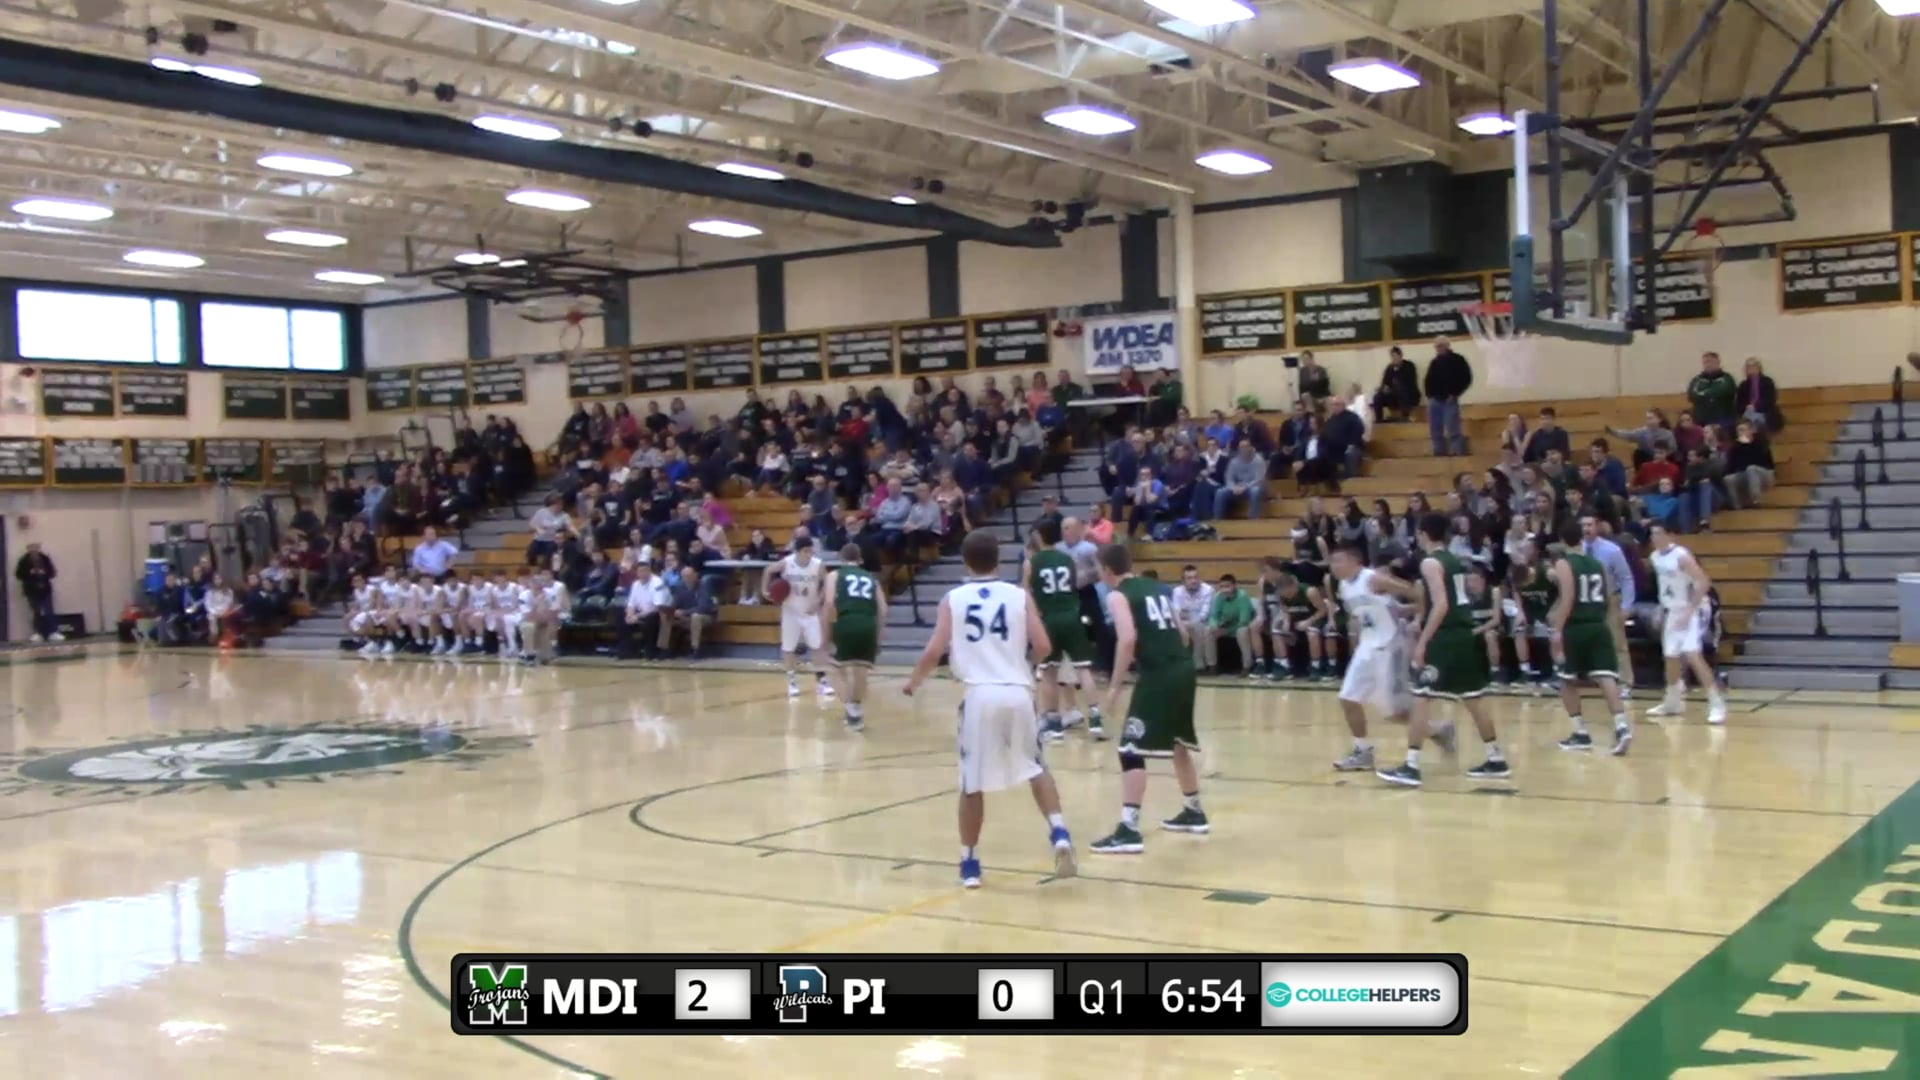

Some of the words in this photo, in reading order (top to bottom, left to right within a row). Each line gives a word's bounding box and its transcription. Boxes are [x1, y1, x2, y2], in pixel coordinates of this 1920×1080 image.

[1093, 322, 1173, 351] WDEA
[1094, 352, 1122, 366] AM
[845, 574, 873, 599] 22
[1040, 566, 1071, 593] 32
[1578, 574, 1604, 602] 12
[965, 603, 1010, 643] 54
